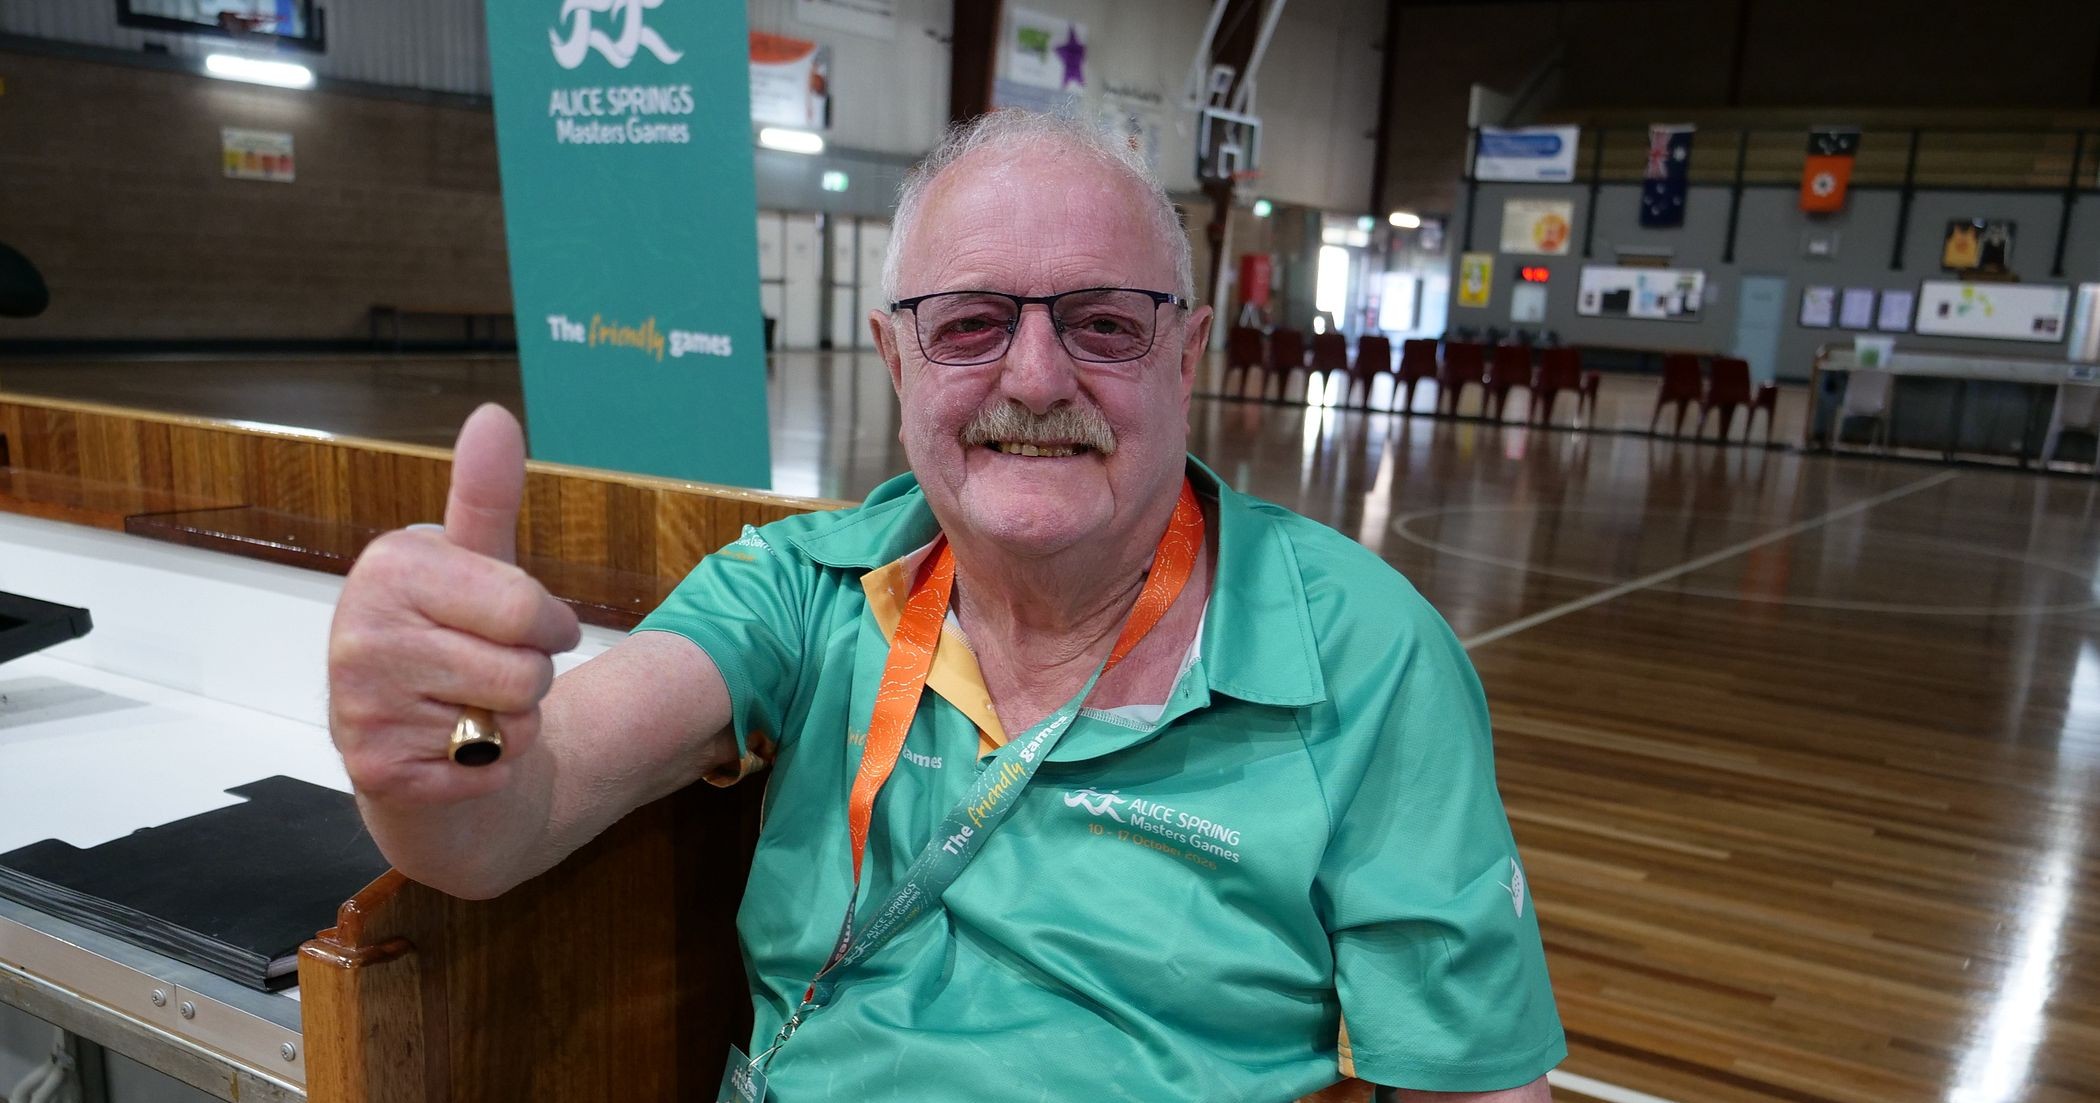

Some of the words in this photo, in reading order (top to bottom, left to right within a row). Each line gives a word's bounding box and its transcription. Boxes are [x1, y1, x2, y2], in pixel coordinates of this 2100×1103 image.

[549, 87, 604, 117] ALICE
[606, 84, 695, 116] SPRINGS
[555, 116, 625, 144] Masters
[625, 115, 690, 144] Games
[546, 313, 585, 344] The
[588, 312, 664, 363] friendly
[668, 328, 732, 358] games
[901, 743, 943, 769] ames
[942, 825, 974, 855] The
[966, 761, 1027, 828] friendly
[1019, 715, 1068, 763] games
[1127, 798, 1176, 825] ALICE
[1130, 813, 1187, 844] Masters
[1189, 833, 1241, 864] Games
